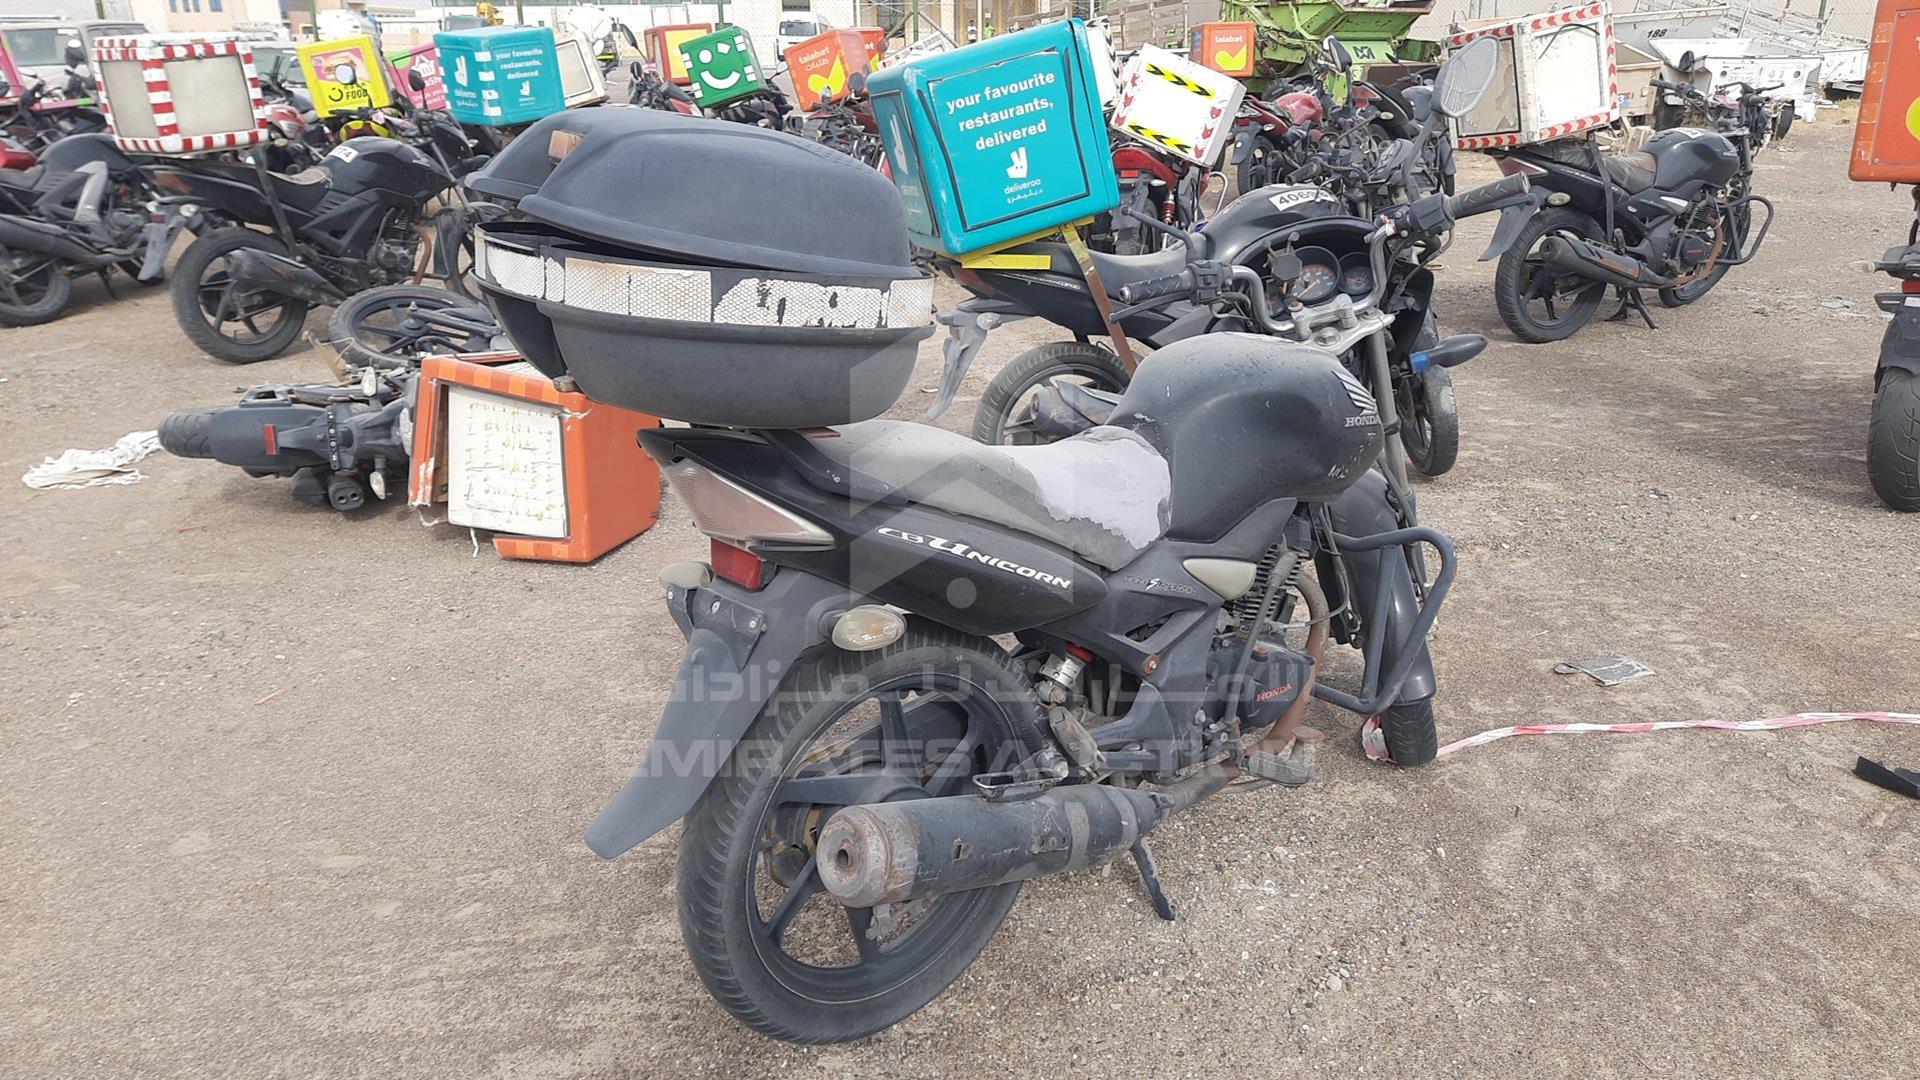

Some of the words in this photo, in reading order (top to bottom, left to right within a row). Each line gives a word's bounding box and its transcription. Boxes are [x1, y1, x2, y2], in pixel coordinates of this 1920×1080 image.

[1215, 34, 1243, 43] talabat
[1647, 29, 1668, 38] 188
[512, 49, 543, 58] favourite
[799, 46, 830, 65] talabat
[506, 70, 539, 79] delivered
[345, 88, 369, 101] FOOD
[946, 93, 981, 114] your
[983, 72, 1056, 101] favourite
[958, 97, 1054, 131] restaurants,
[975, 119, 1047, 151] delivered
[1003, 178, 1042, 195] deliveroo
[1344, 414, 1382, 428] HONDA
[1256, 683, 1292, 702] HONDA
